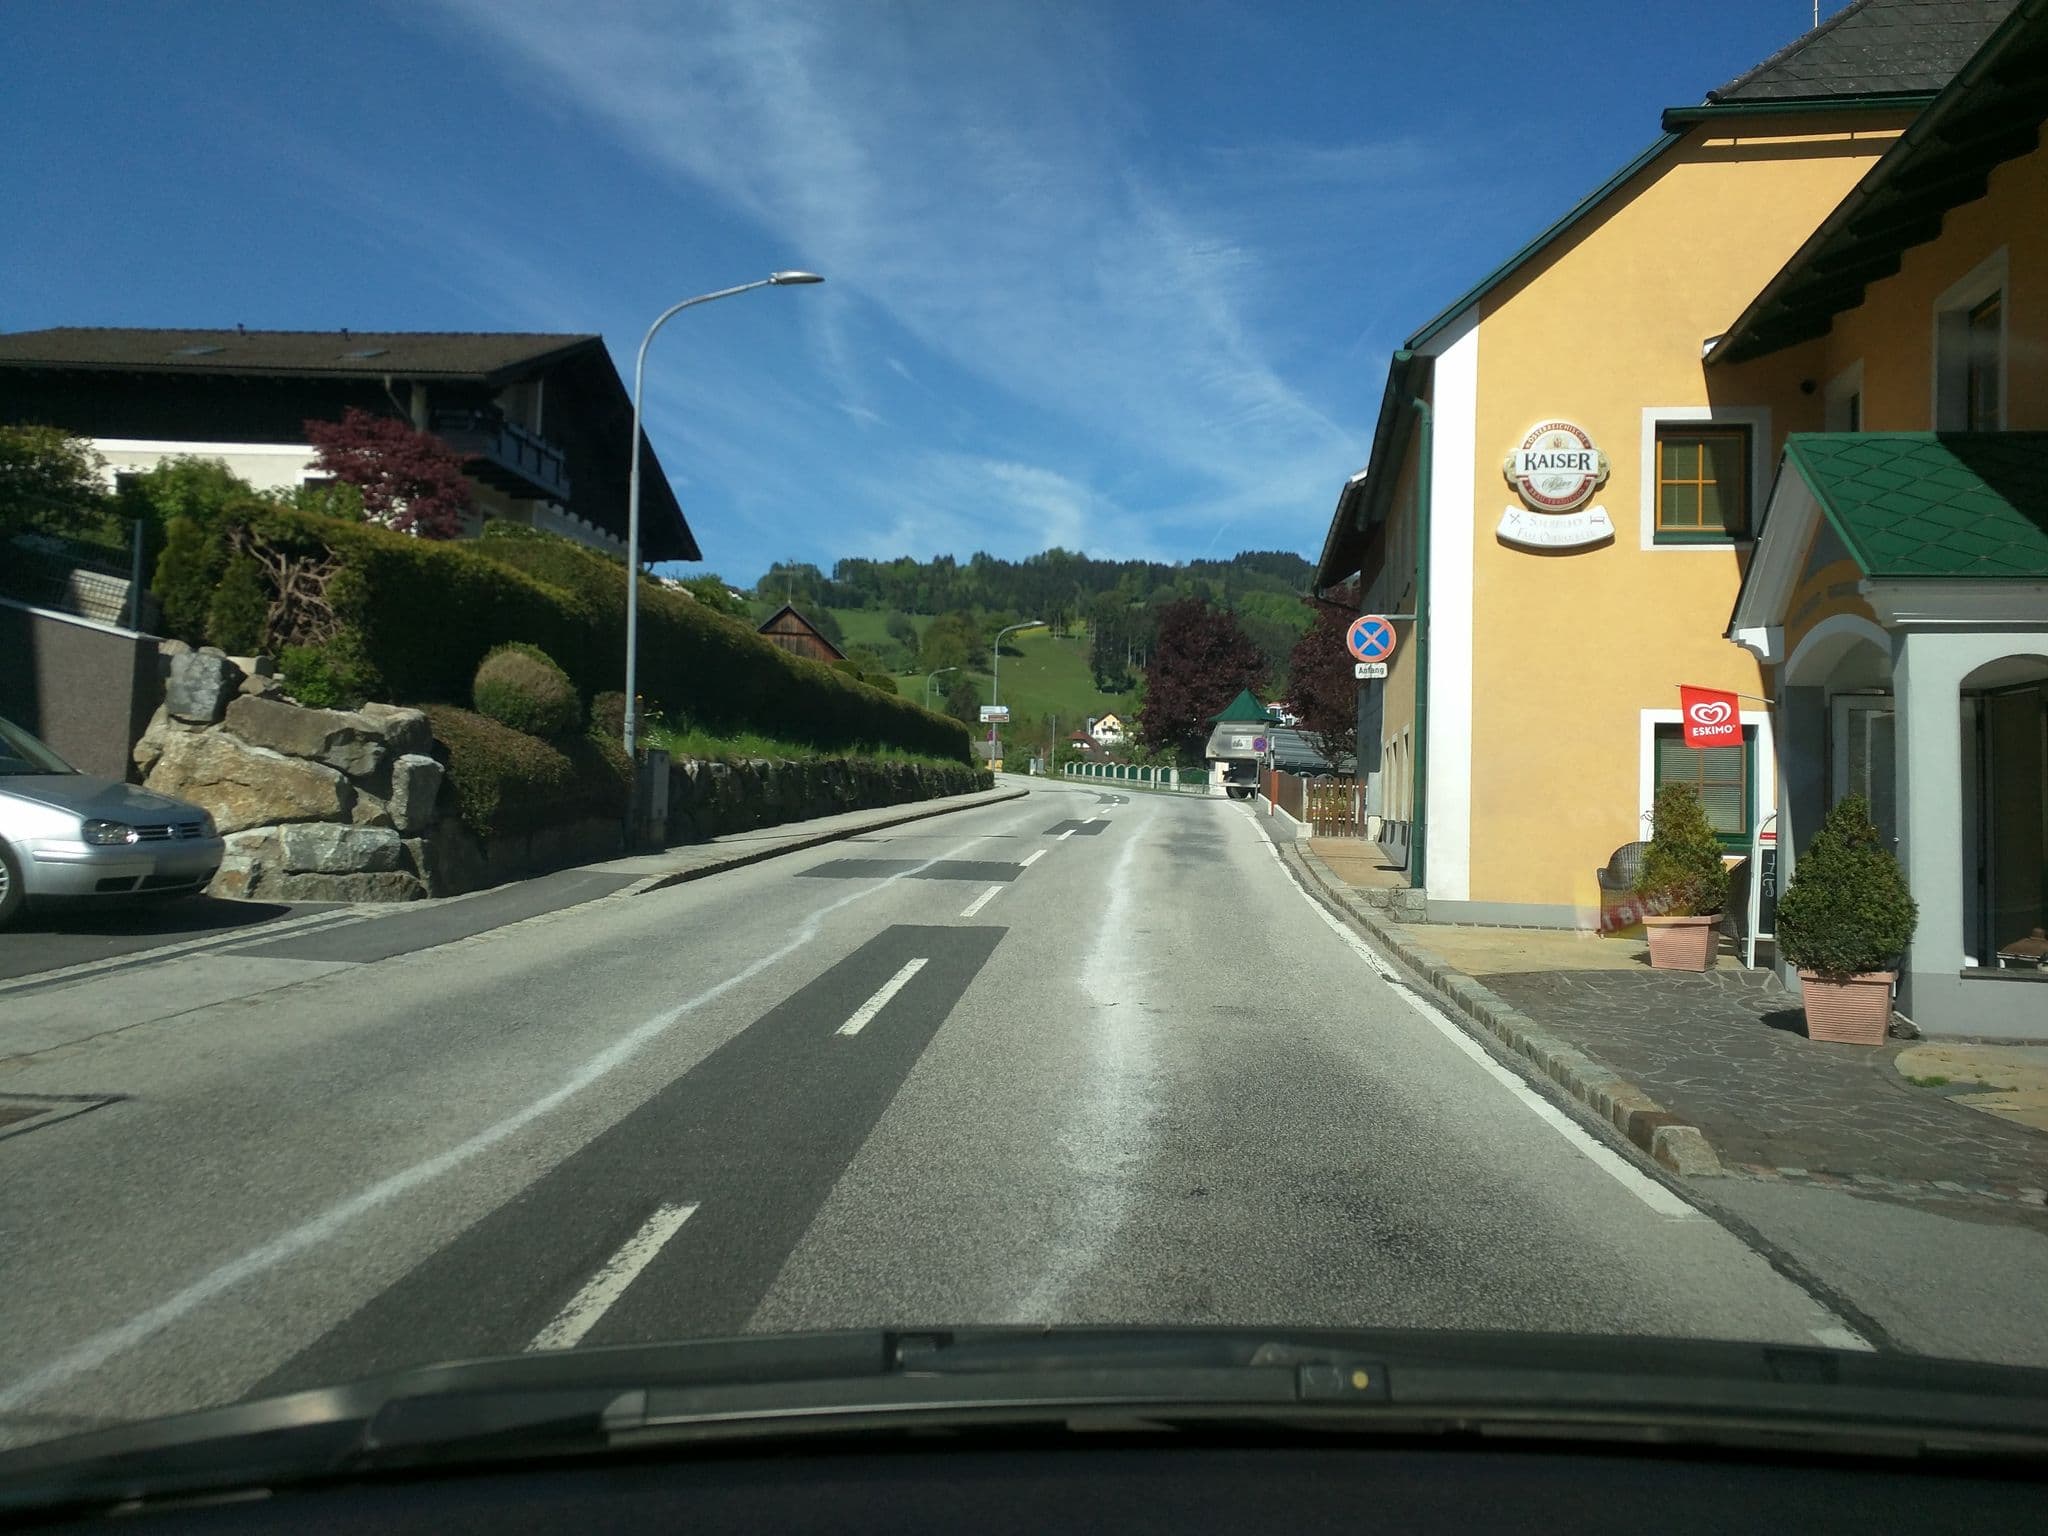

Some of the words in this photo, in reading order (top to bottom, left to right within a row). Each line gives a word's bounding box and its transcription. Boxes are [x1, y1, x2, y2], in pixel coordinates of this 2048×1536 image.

[1524, 452, 1591, 471] KAISER
[1358, 665, 1385, 675] Anfang
[1692, 724, 1733, 737] ESKIMO
